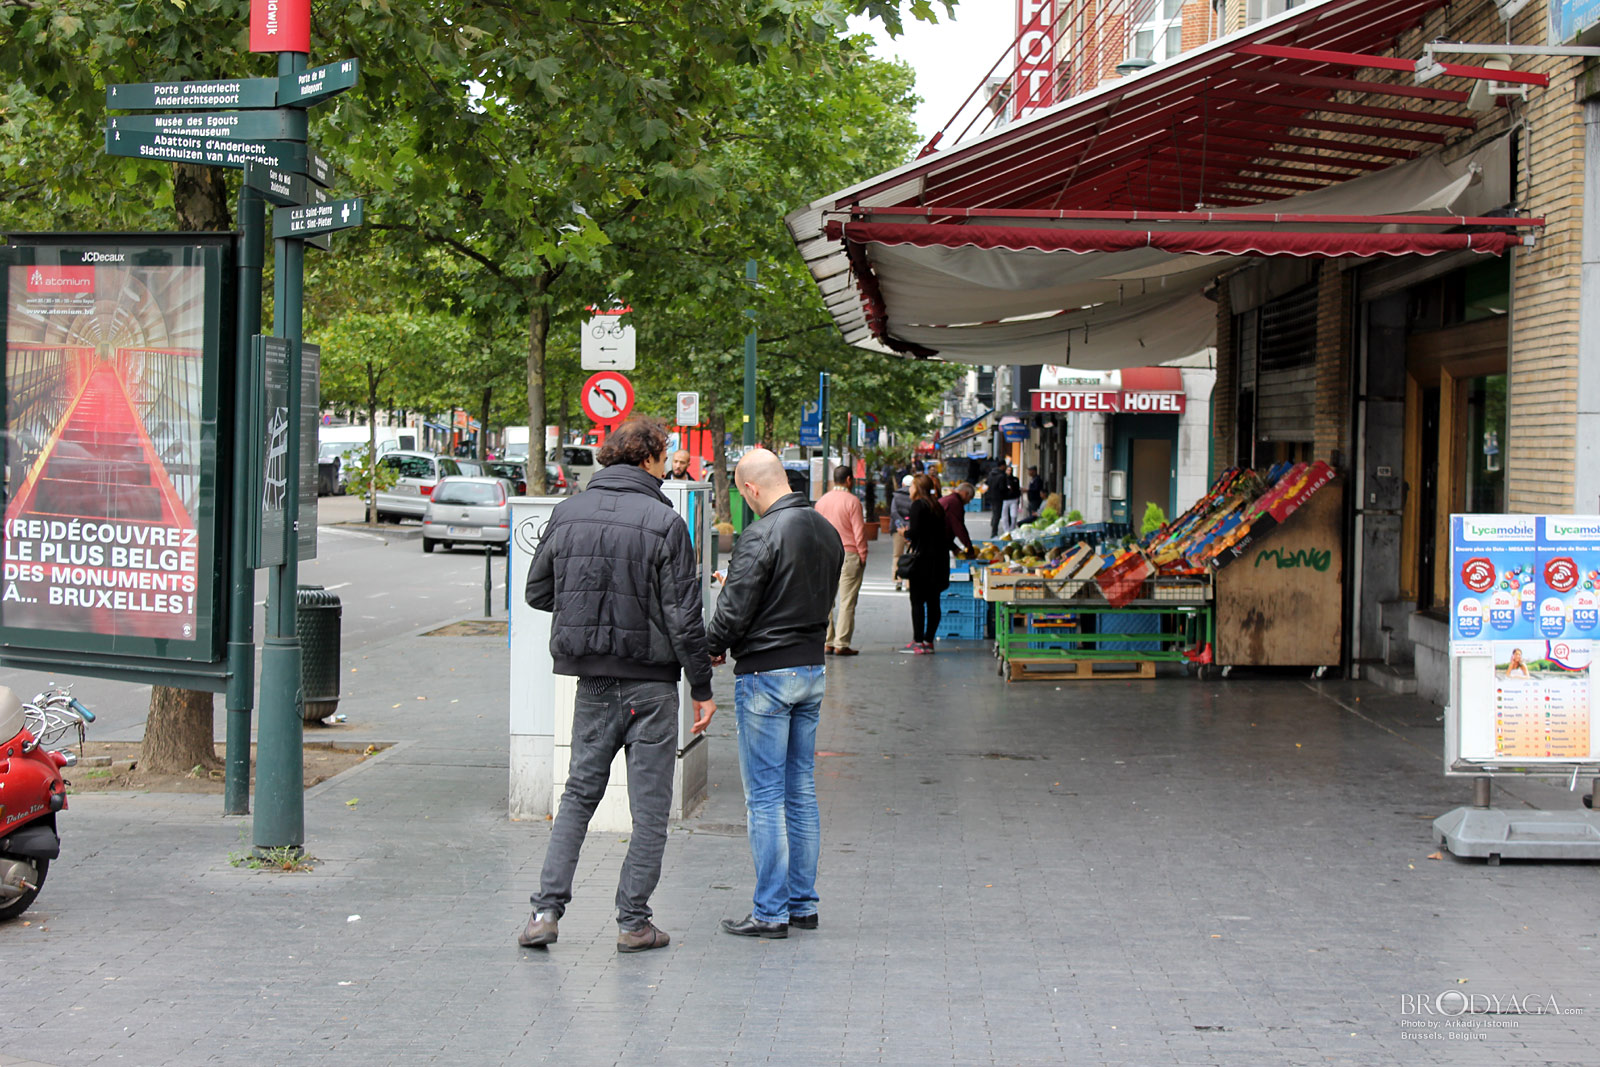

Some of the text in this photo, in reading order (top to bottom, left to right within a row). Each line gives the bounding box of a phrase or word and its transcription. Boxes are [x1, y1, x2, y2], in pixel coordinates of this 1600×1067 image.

[154, 83, 240, 95] Porte d'Anderlecht
[155, 94, 239, 105] Anderlechtsepoort
[155, 115, 239, 127] Musée des Egouts
[154, 135, 266, 154] Abattoirs d'Anderlecht
[140, 145, 202, 160] Slachthuizen
[206, 152, 223, 162] van
[305, 205, 333, 218] Saint-Pierre
[306, 217, 333, 229] Sint-Pieter
[81, 251, 125, 263] JCDecaux
[44, 277, 91, 287] atomium
[26, 308, 95, 316] www.atomium.be
[1040, 392, 1111, 410] HOTEL
[1124, 393, 1181, 412] HOTEL
[804, 401, 818, 422] P
[1296, 477, 1326, 506] LETABA
[5, 518, 197, 548] (RE)DÉCOUVREZ
[1472, 524, 1534, 537] Lycamobile
[5, 540, 196, 572] LE PLUS BELGE
[4, 563, 196, 593] DES MONUMENTS
[1492, 610, 1512, 620] 10€
[1575, 610, 1595, 620] 10€
[1459, 617, 1480, 626] 25€
[1541, 617, 1562, 626] 25€
